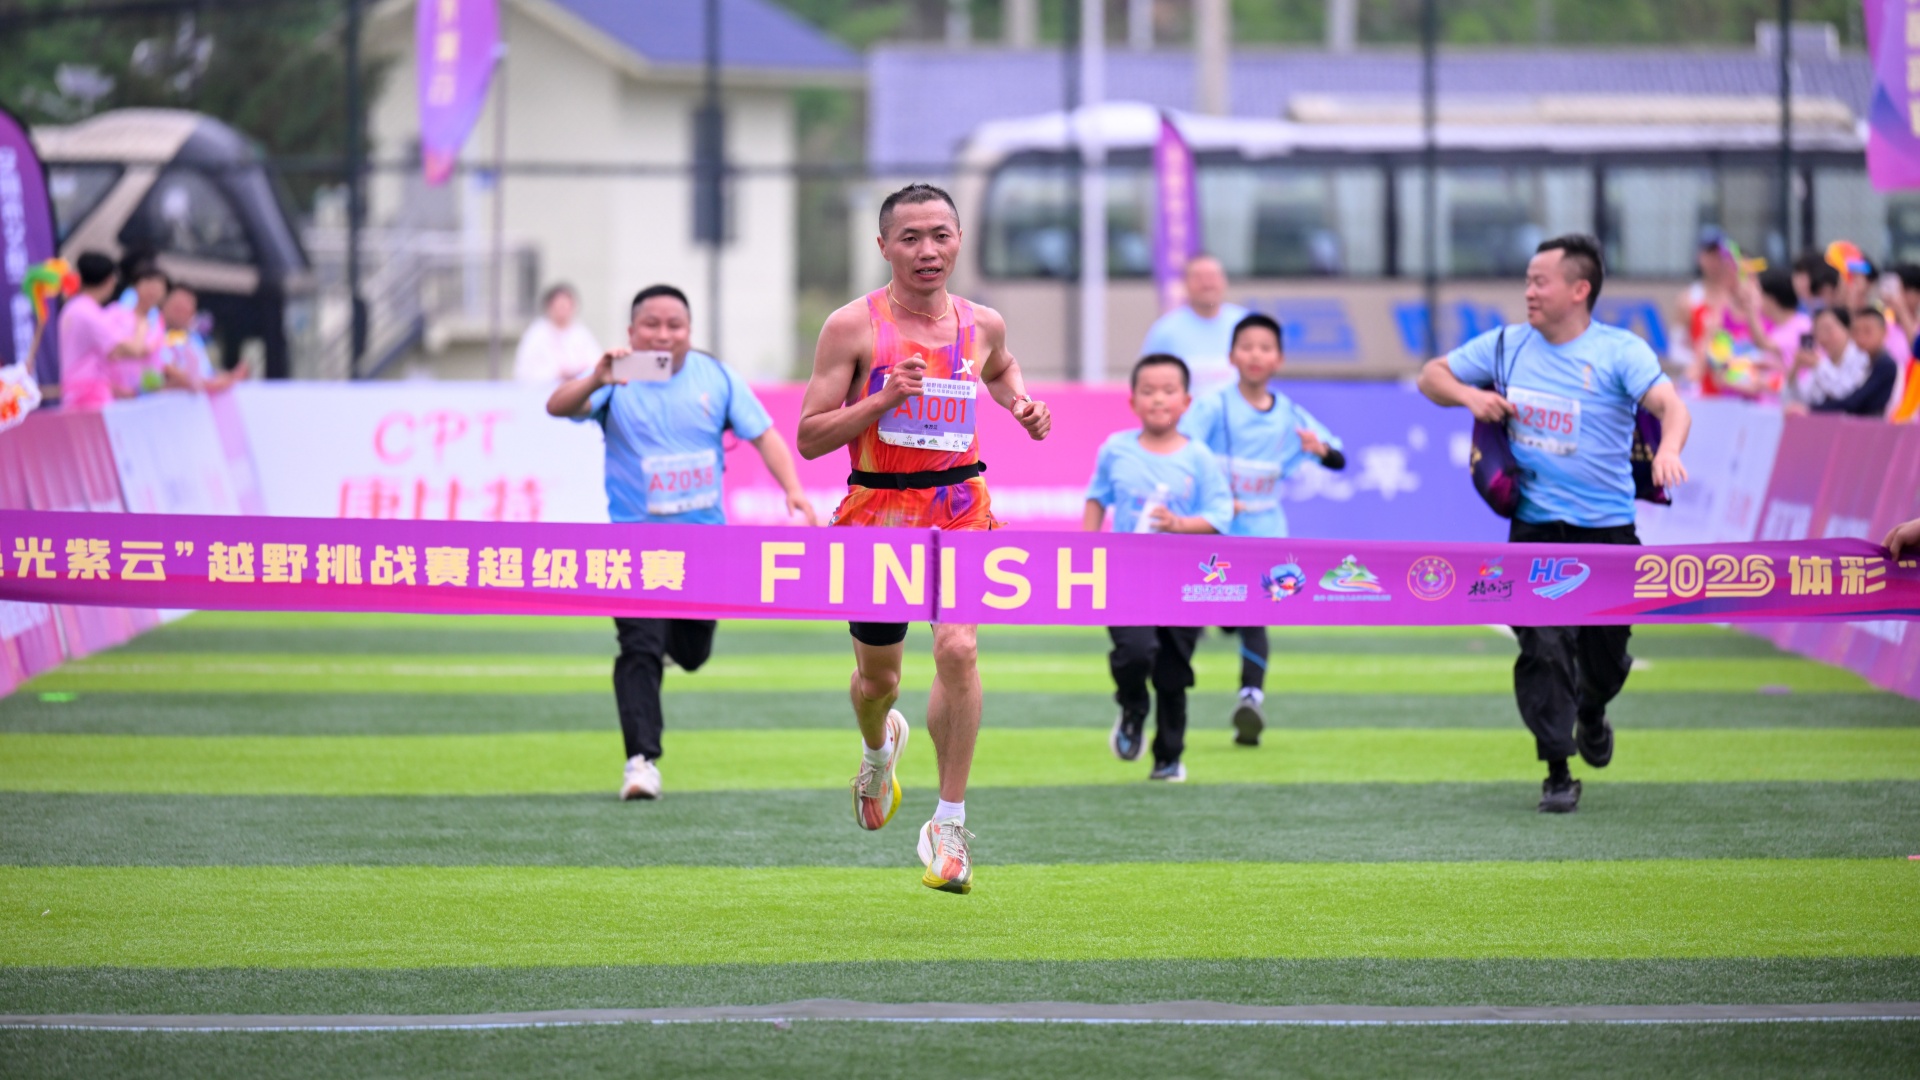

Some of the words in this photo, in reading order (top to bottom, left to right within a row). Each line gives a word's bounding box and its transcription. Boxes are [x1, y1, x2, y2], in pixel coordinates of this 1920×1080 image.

[893, 395, 968, 424] A1001
[0, 536, 686, 591] 光紫云”越野挑战赛超级联赛
[760, 541, 1107, 610] FINISH
